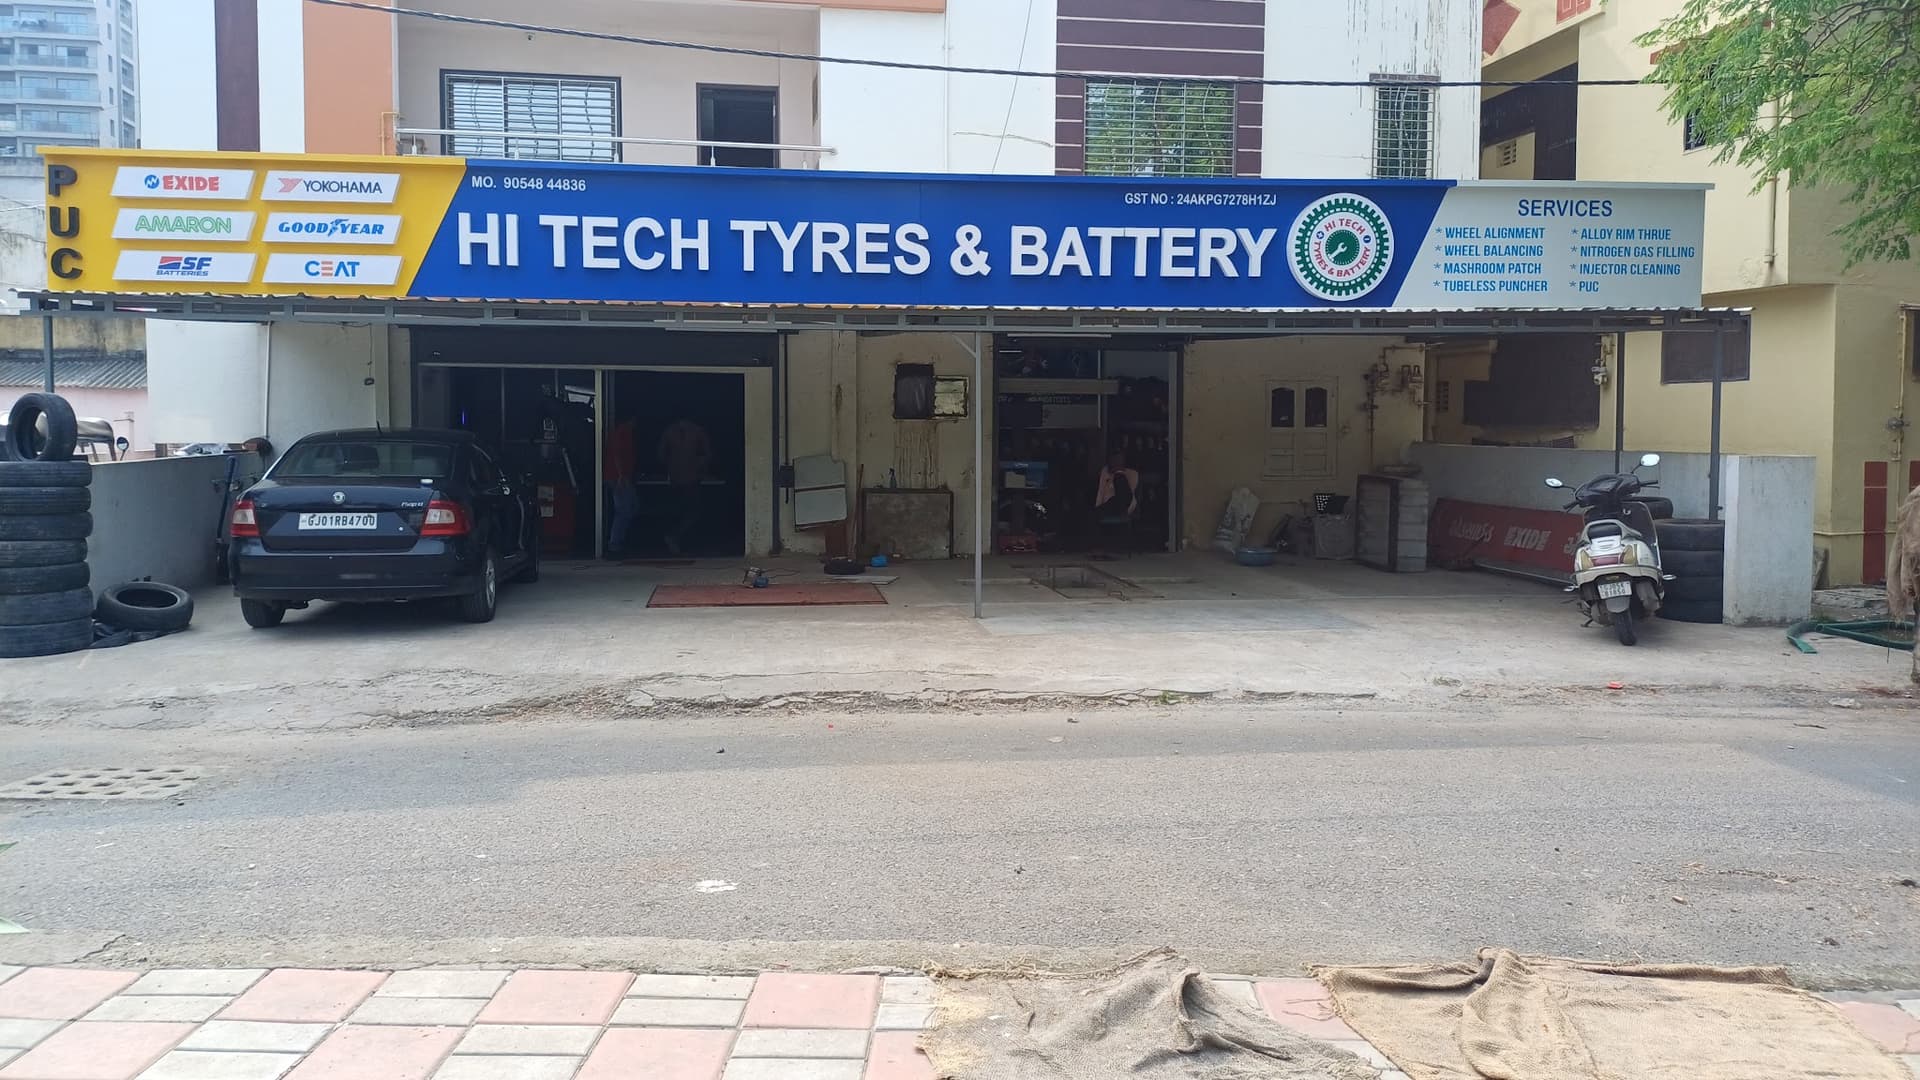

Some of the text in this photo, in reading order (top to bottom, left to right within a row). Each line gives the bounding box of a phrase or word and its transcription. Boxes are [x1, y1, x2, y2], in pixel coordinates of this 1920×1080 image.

[162, 175, 220, 192] EXIDE
[303, 179, 383, 194] YOKOHAMA
[471, 176, 586, 192] MO. 90548 44836
[1125, 193, 1150, 205] GST
[1151, 193, 1169, 205] NO
[1177, 193, 1277, 206] 24AKPG7278H1ZJ
[1518, 199, 1613, 218] SERVICES
[47, 164, 83, 280] PUC
[135, 214, 232, 234] AMARON
[278, 218, 385, 238] GOODYEAR
[1324, 218, 1366, 235] HI TECH
[1445, 227, 1545, 240] WHEEL ALIGNMENT
[1580, 228, 1671, 241] ALLOY RIM THRUE
[458, 212, 1278, 278] HI TECH TYRES & BATTERY
[1444, 244, 1544, 257] WHEEL BALANCING
[1580, 246, 1695, 258] NITROGEN GAS FILLING
[1313, 240, 1371, 278] TYRES & BATTERY
[155, 269, 209, 277] BATTERIES
[304, 260, 360, 278] CEAT
[1443, 262, 1542, 275] MASHROOM PATCH
[1579, 263, 1681, 276] INJECTOR CLEANING
[1443, 280, 1548, 292] TUBELESS PUNCHER
[1578, 281, 1599, 293] PUC
[1504, 526, 1552, 551] EXIDE
